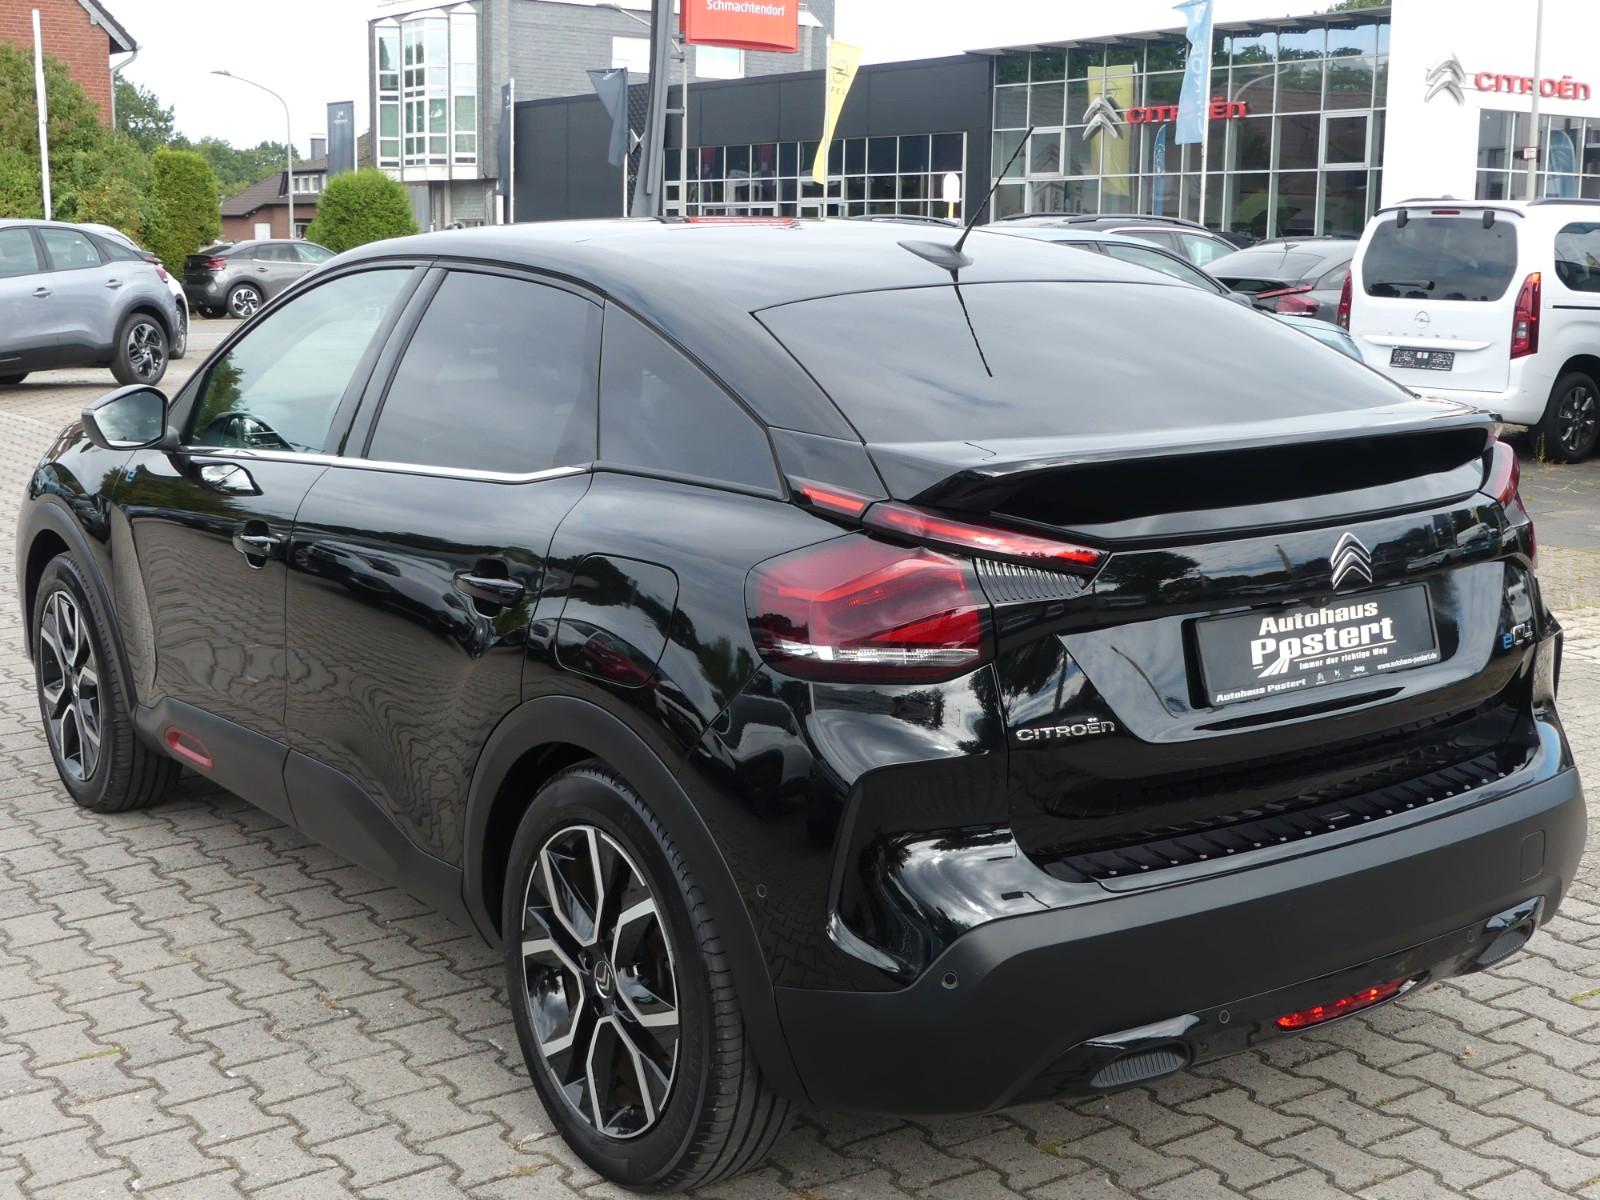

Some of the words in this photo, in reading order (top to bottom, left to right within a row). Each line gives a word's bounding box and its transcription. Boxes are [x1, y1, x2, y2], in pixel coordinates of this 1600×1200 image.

[706, 0, 785, 16] Schmachtendorf
[1258, 602, 1379, 636] Autohaus
[1250, 617, 1394, 668] Postert
[1325, 656, 1339, 666] der
[1341, 650, 1370, 663] richtige
[1372, 647, 1388, 657] Weg
[1216, 687, 1266, 703] Autohaus
[1267, 678, 1307, 693] Postert
